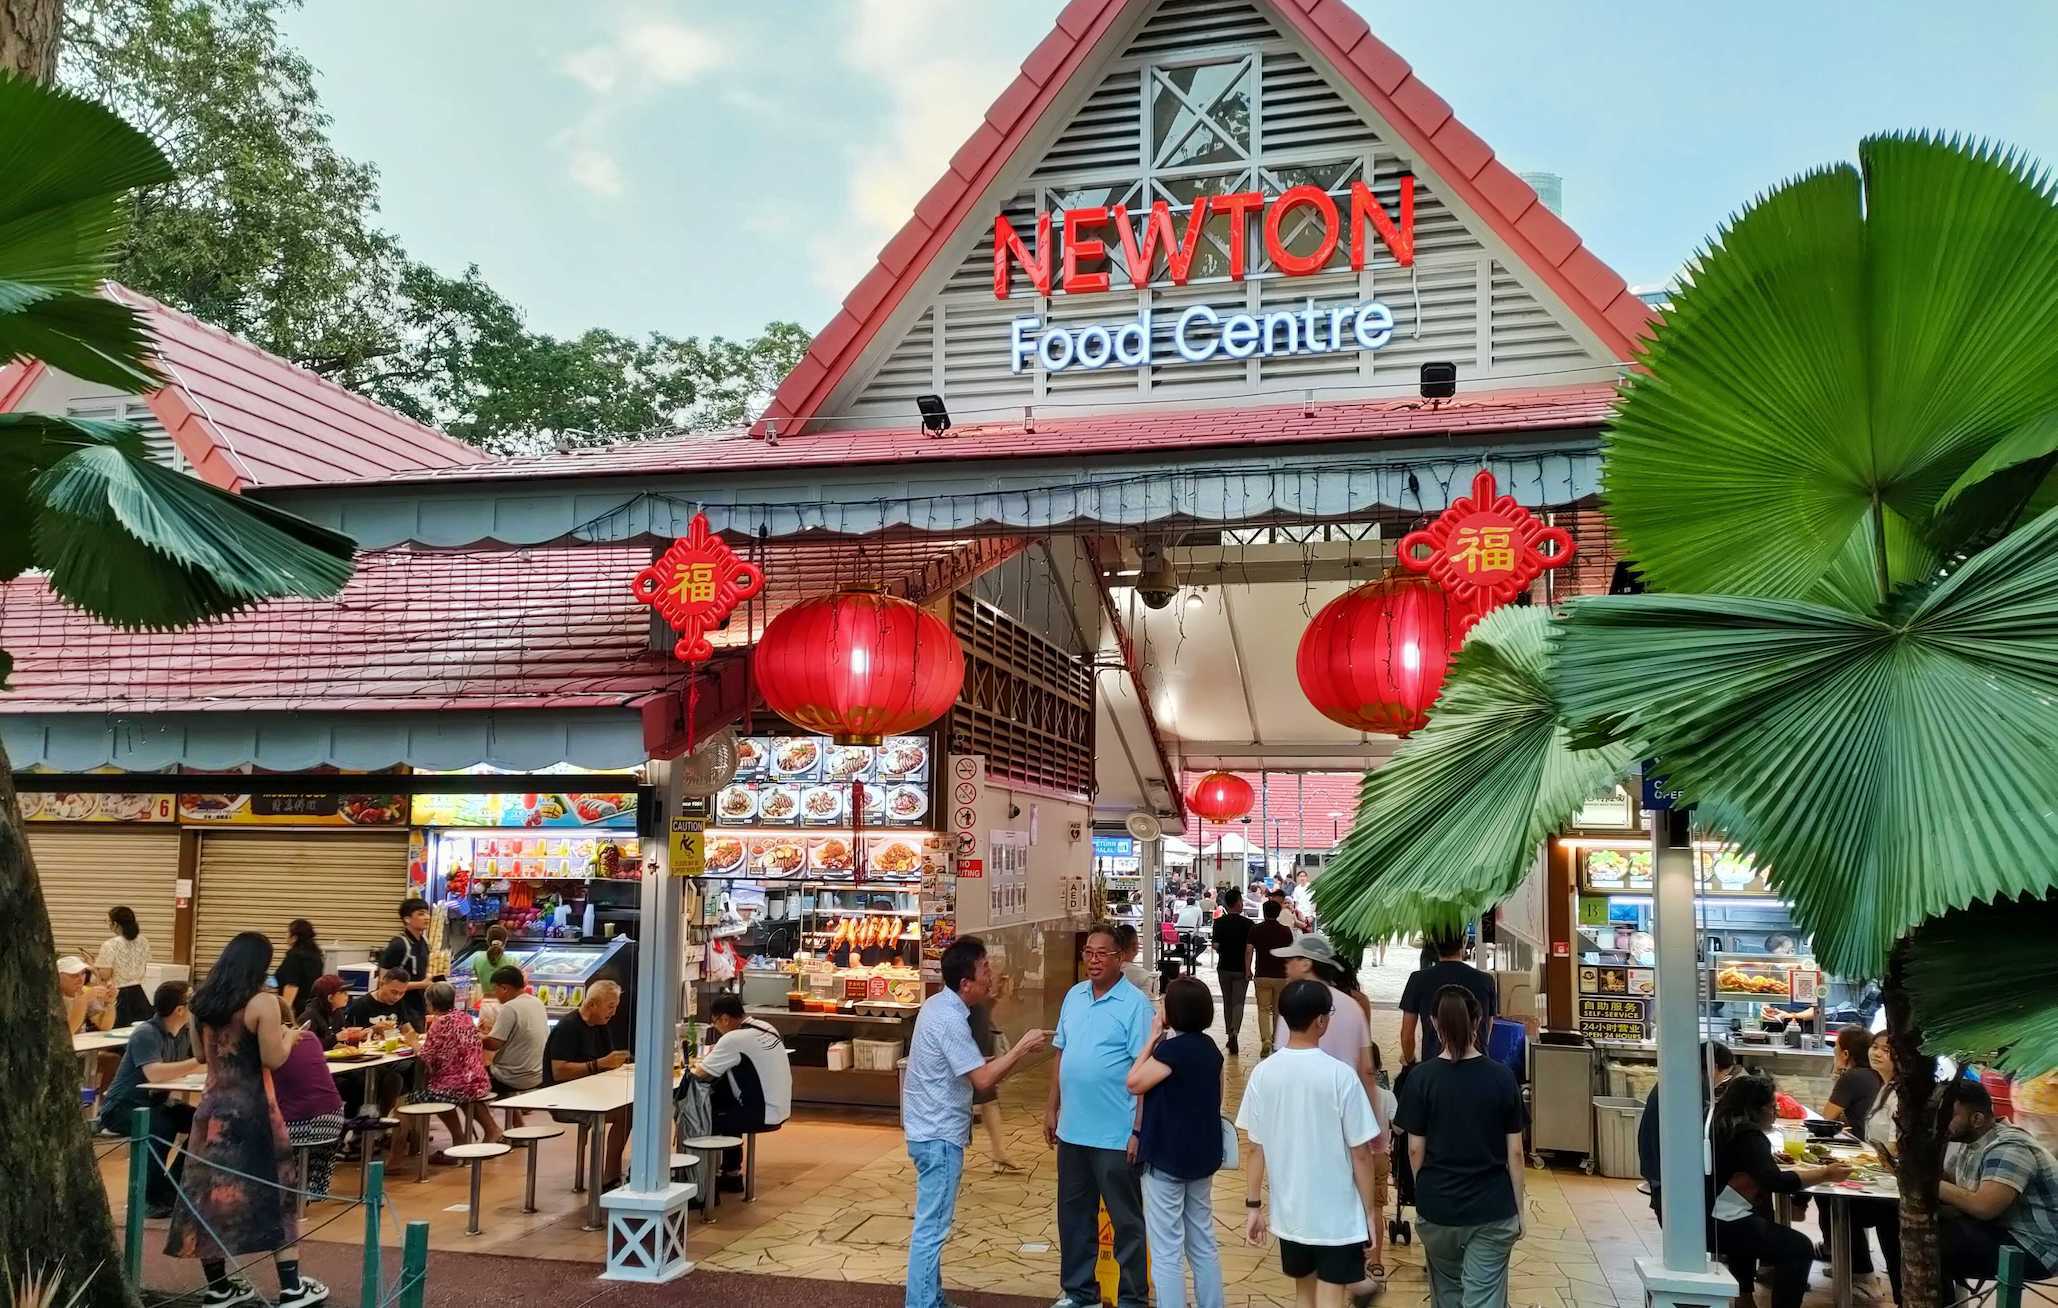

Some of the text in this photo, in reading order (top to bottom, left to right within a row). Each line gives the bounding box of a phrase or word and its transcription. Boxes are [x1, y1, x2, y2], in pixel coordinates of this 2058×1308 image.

[994, 175, 1414, 300] NEWTON
[1011, 299, 1393, 374] Food Centre
[1449, 527, 1515, 574] 福
[667, 563, 717, 604] 福
[159, 799, 169, 817] 6
[672, 820, 703, 832] CAUTION
[960, 869, 980, 877] UTING
[1584, 1001, 1636, 1012] 自助服务
[1583, 1010, 1639, 1019] SELF-SERVICE
[1582, 1022, 1641, 1033] 24小时营业
[1583, 1031, 1603, 1039] OPEN
